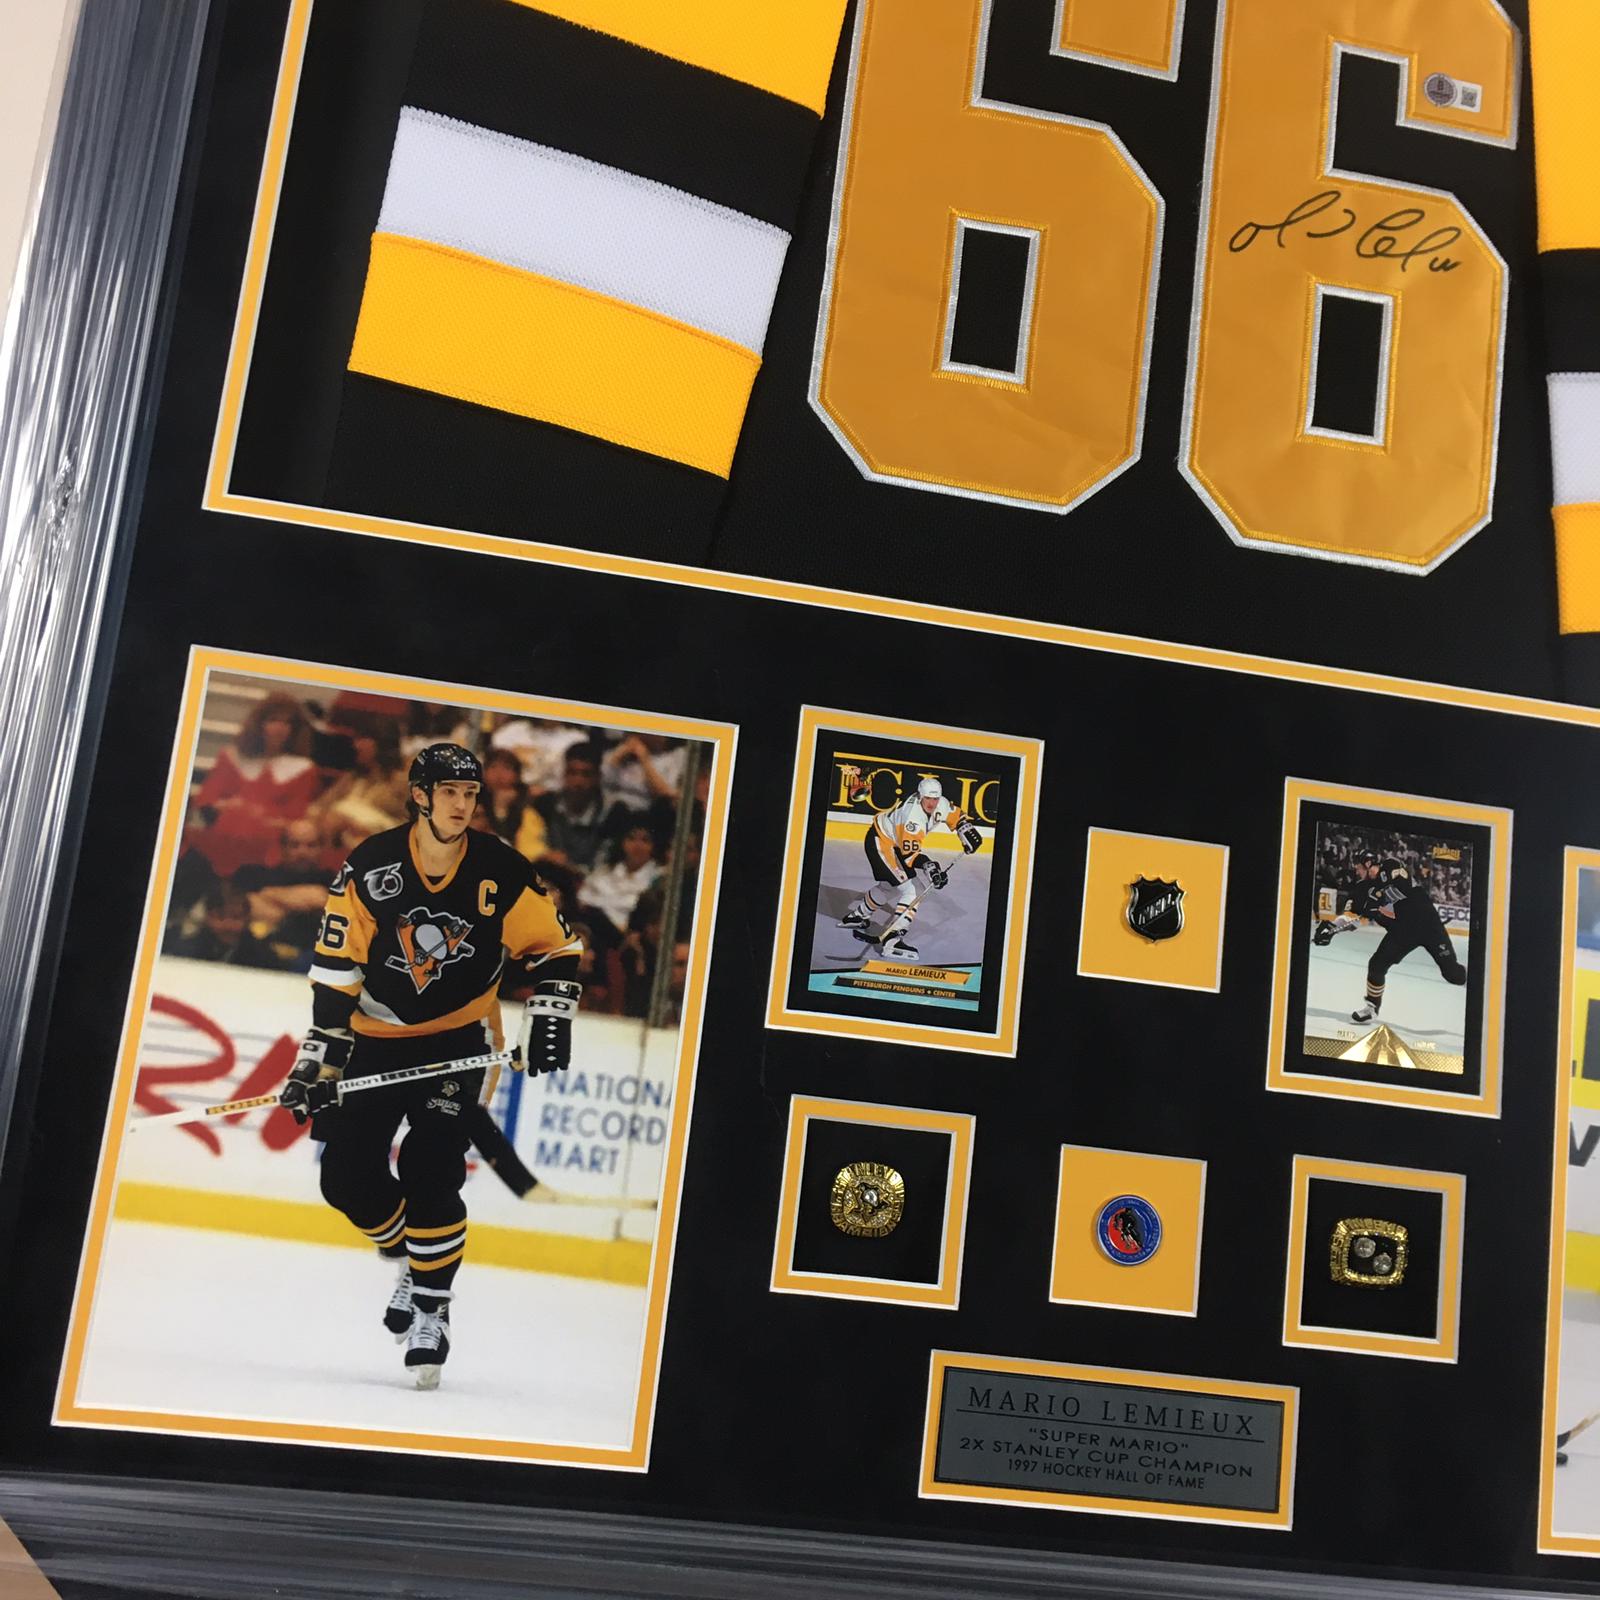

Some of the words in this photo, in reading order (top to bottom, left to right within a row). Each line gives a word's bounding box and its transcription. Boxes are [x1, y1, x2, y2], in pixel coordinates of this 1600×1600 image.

[807, 0, 1521, 577] 66
[902, 839, 920, 852] 66
[478, 879, 498, 917] C
[852, 979, 893, 992] PITTSBURGH
[893, 984, 925, 995] PENGUINS
[932, 990, 956, 999] CENTER
[885, 967, 908, 975] MARIO
[908, 967, 947, 980] LEMIEUX
[539, 1102, 667, 1146] RECORD
[534, 1139, 621, 1175] MART
[967, 1387, 1082, 1418] MARIO
[1101, 1401, 1255, 1436] LEMIEUX
[959, 1437, 985, 1451] 2X
[993, 1440, 1080, 1461] STANLEY
[1087, 1450, 1130, 1465] CUP
[1138, 1455, 1254, 1478] CHAMPION
[1029, 1427, 1101, 1447] "SUPER
[1109, 1435, 1189, 1454] MARIO"
[1008, 1459, 1038, 1473] 1997
[1043, 1462, 1102, 1480] HOCKEY
[1106, 1467, 1139, 1484] HALL
[1145, 1471, 1164, 1485] OF
[1168, 1475, 1206, 1490] FAME
